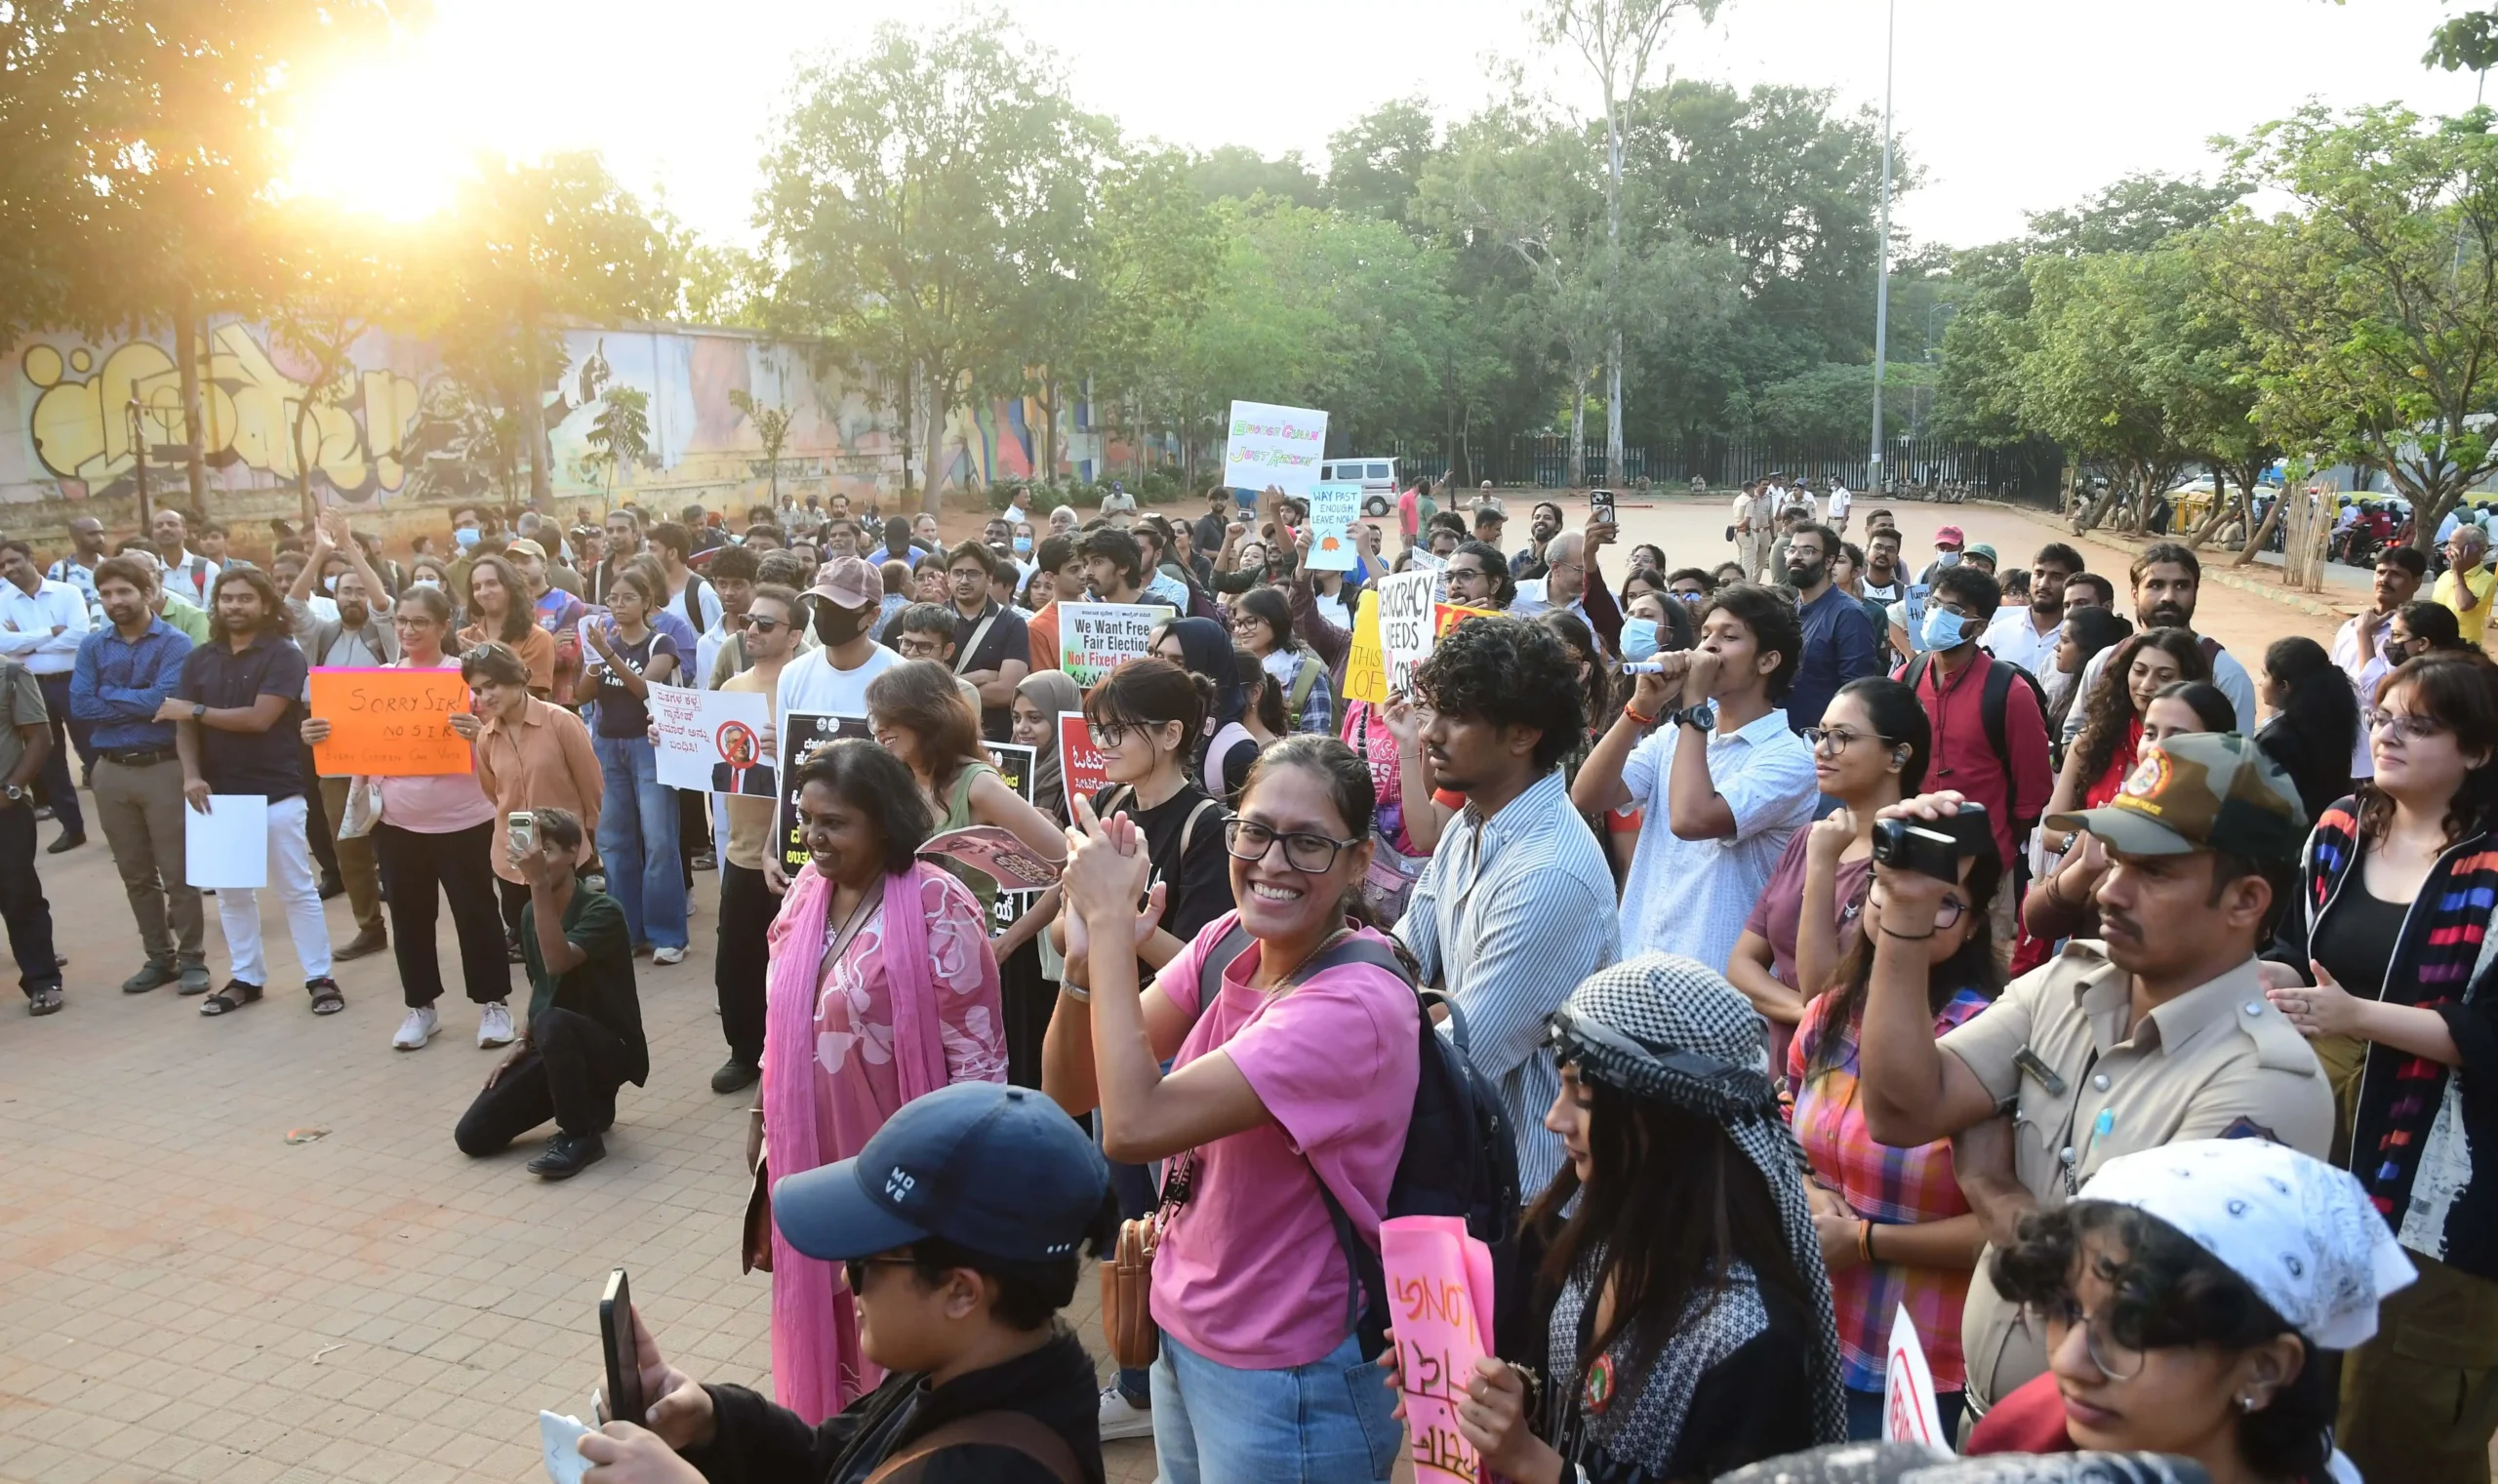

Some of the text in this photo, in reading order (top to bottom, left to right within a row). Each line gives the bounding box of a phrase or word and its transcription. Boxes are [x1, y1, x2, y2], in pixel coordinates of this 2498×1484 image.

[1232, 420, 1281, 436] ENOUGH
[1229, 447, 1269, 462] JUST
[1313, 491, 1357, 501] WAY PAST
[1312, 515, 1334, 524] LEAVE
[1414, 548, 1436, 566] MOTHER
[1437, 560, 1446, 569] OF
[1379, 576, 1434, 622] DEMOCRACY
[1074, 619, 1149, 636] We Want Free
[1083, 635, 1104, 650] Fair
[1387, 621, 1419, 651] NEEDS
[1067, 651, 1086, 665] Not
[1089, 652, 1117, 667] Fixed
[1352, 644, 1381, 668] THIS
[1354, 670, 1385, 698] OF
[349, 686, 464, 713] SORRY SIR!
[383, 725, 404, 738] NO
